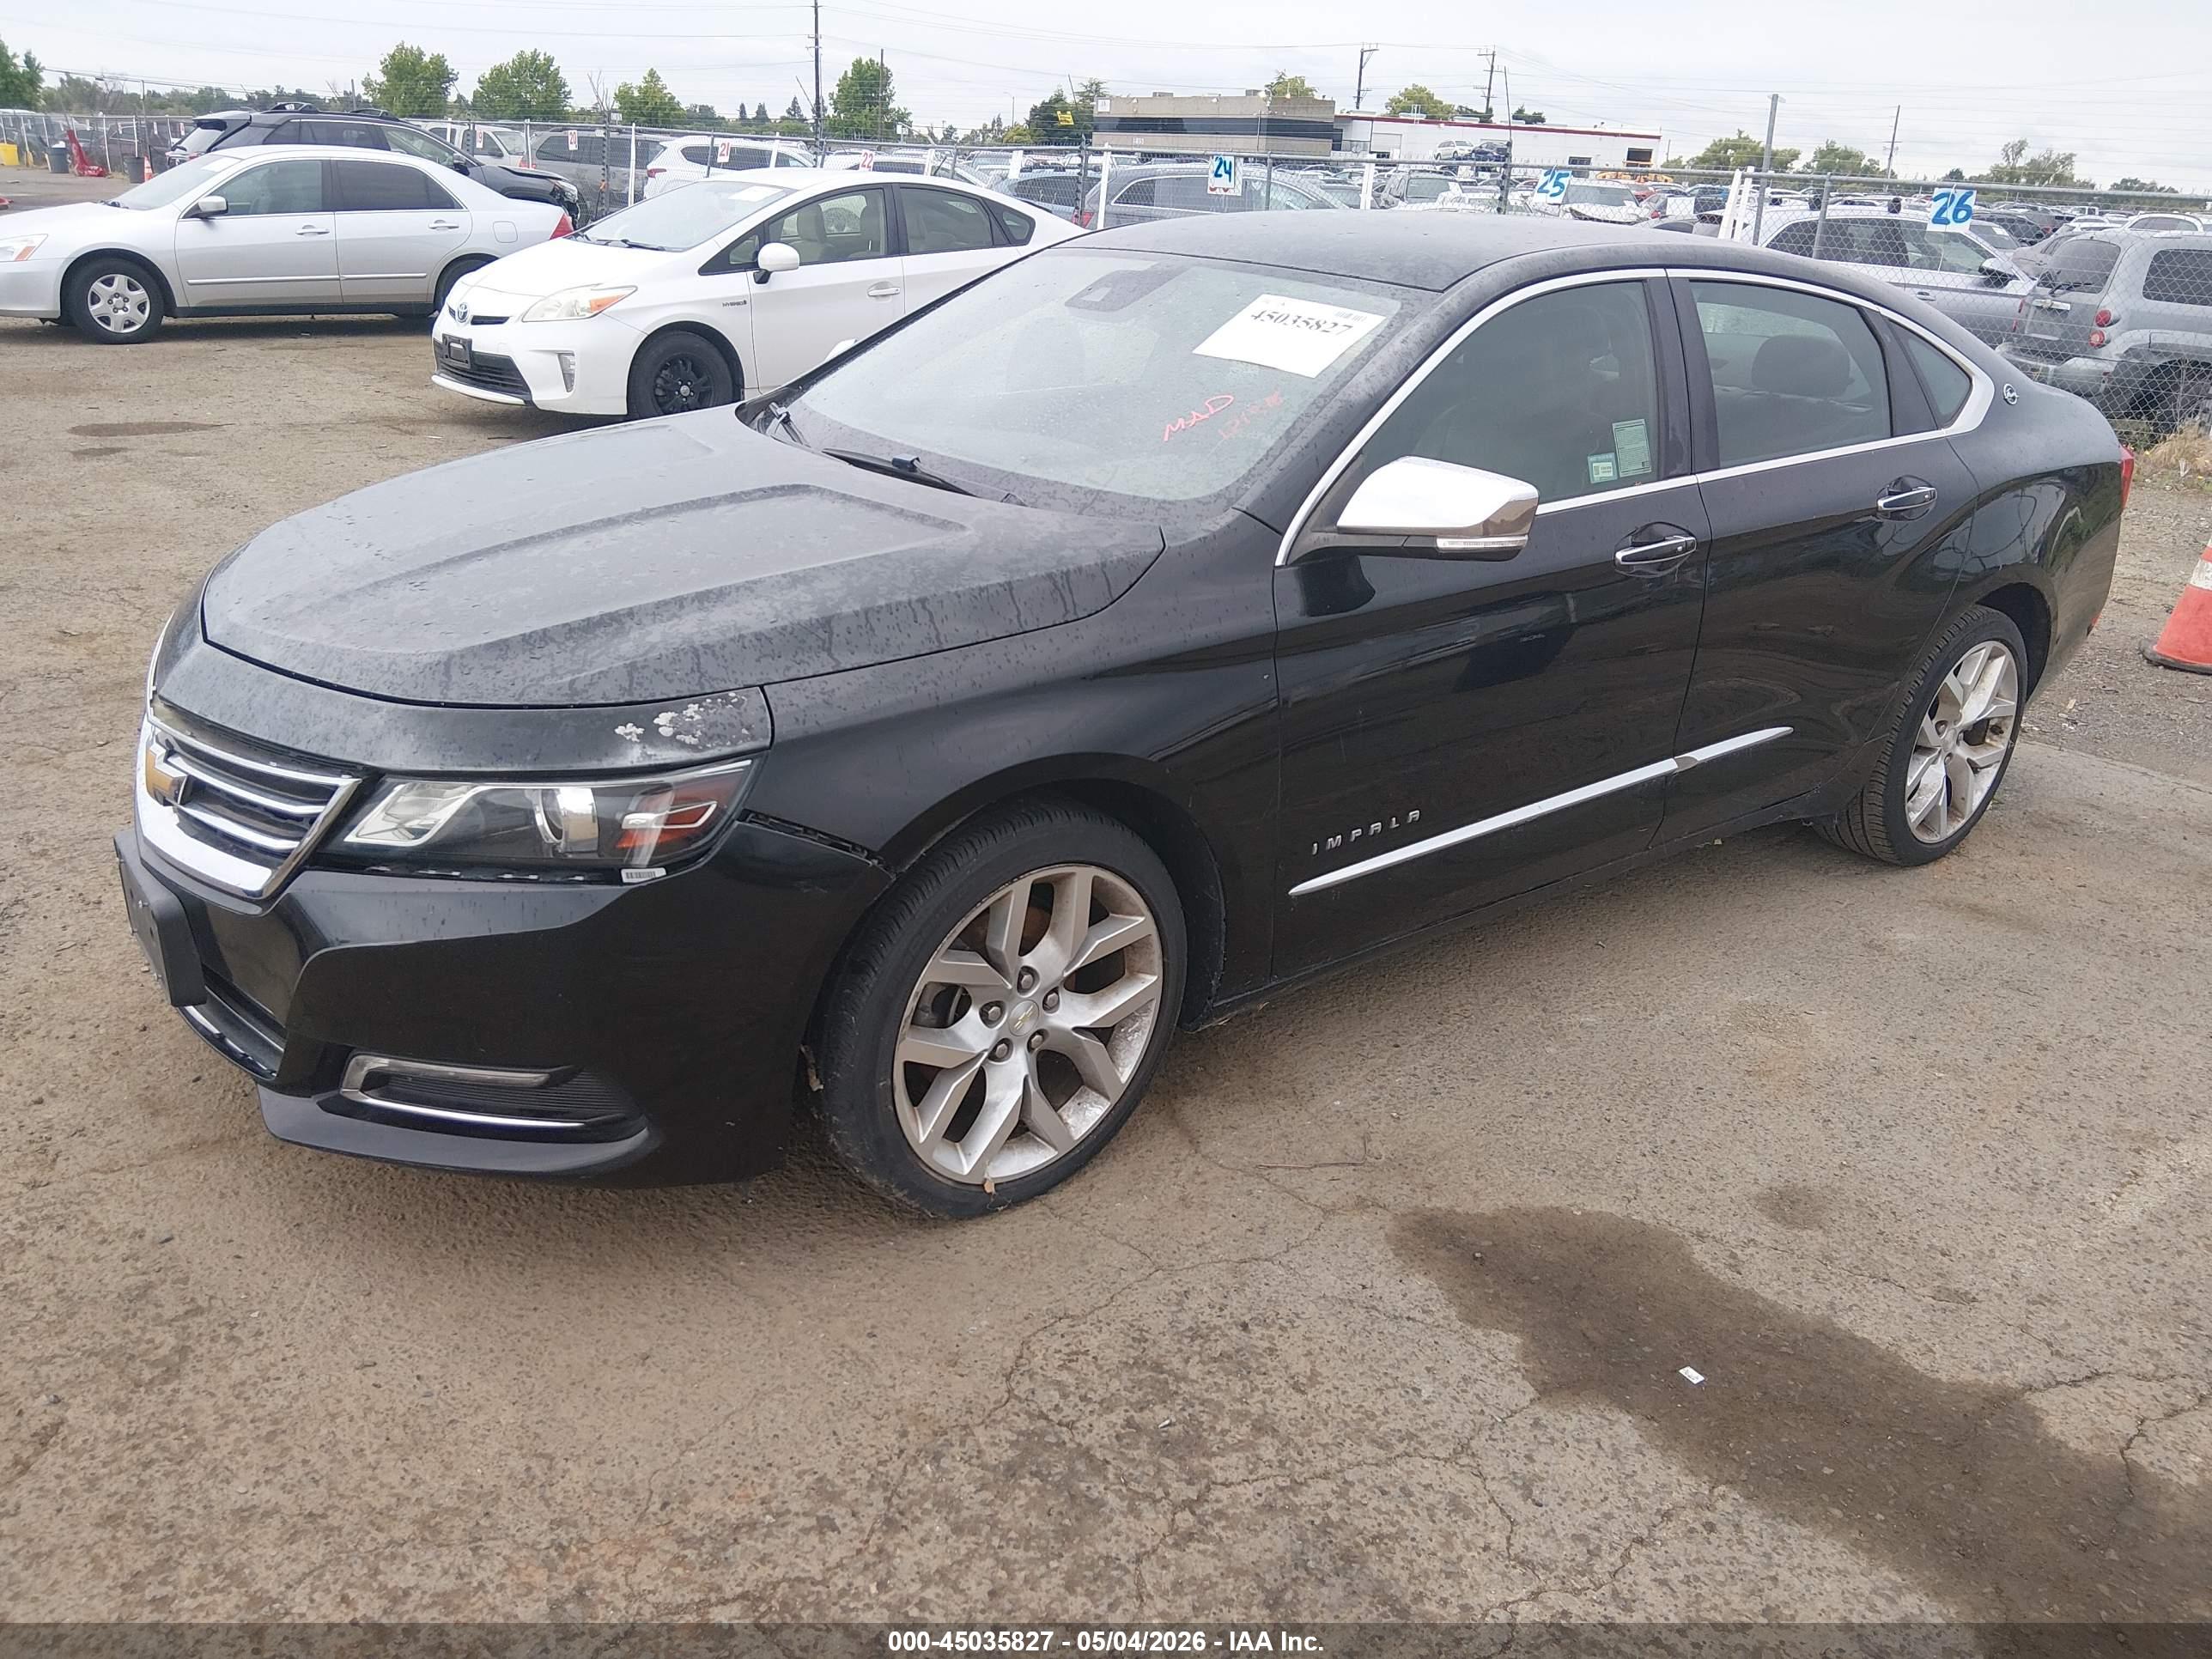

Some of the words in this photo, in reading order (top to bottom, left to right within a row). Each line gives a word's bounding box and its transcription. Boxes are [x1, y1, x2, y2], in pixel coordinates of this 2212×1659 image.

[477, 131, 483, 143] 19
[569, 132, 577, 145] 20
[719, 142, 729, 157] 21
[861, 151, 873, 168] 22
[1213, 156, 1232, 183] 24
[1537, 168, 1570, 198] 25
[1931, 191, 1974, 225] 26
[1250, 309, 1354, 336] 45035827
[1164, 394, 1235, 442] MAD
[1311, 810, 1421, 855] IMPALA
